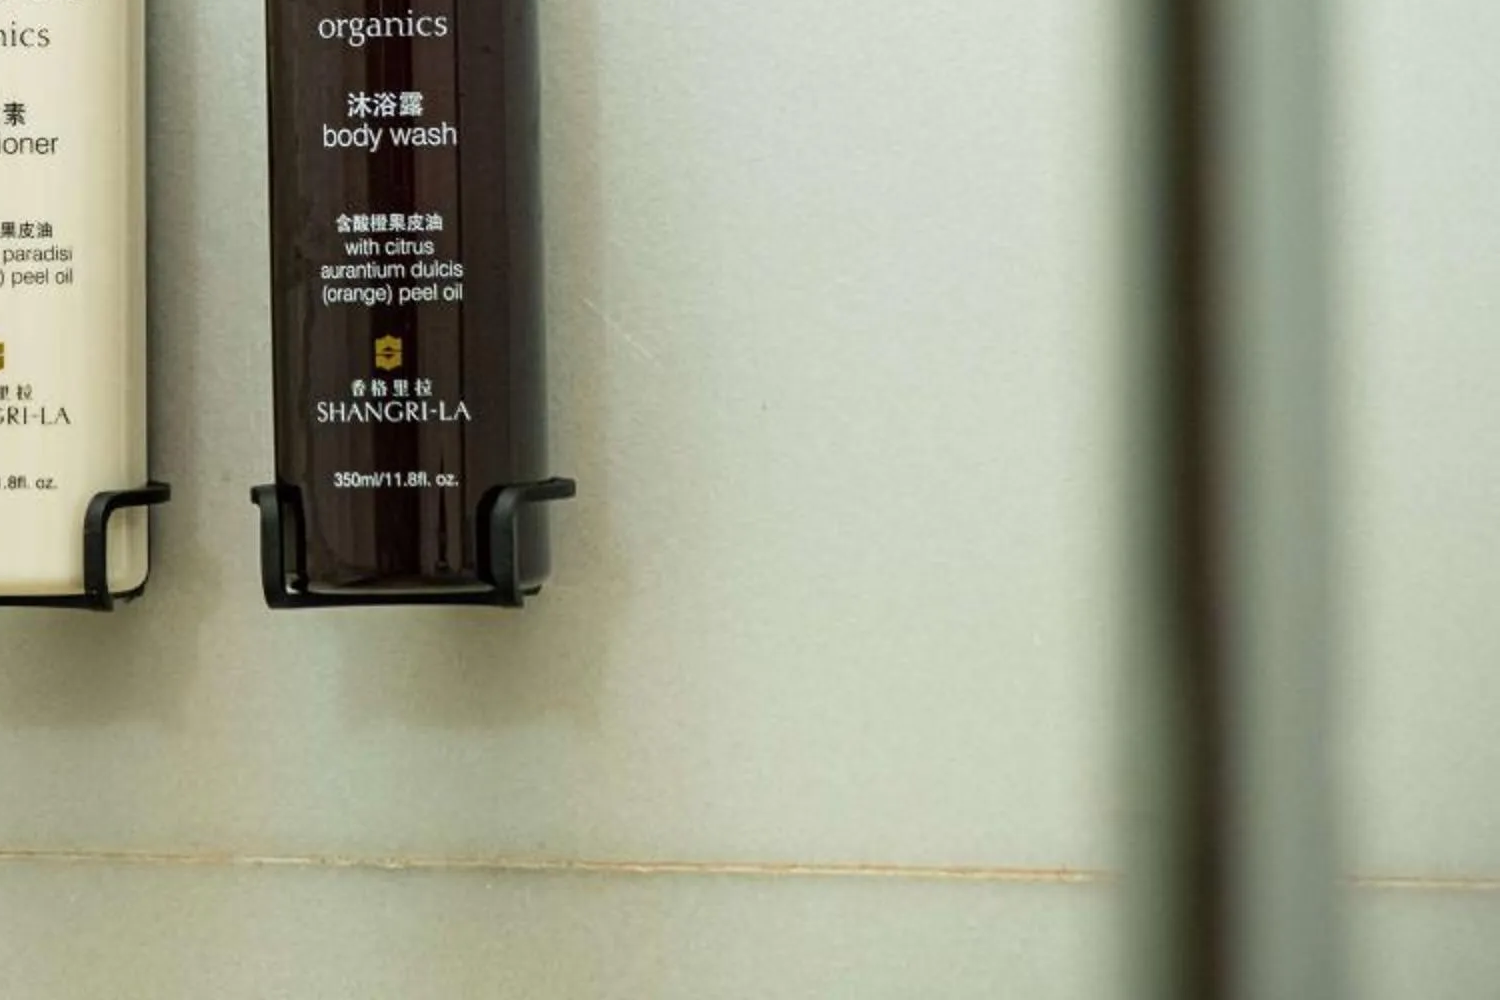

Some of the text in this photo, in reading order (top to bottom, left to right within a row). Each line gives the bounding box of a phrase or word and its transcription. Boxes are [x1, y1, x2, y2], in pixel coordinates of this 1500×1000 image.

[318, 9, 448, 47] organics
[347, 91, 424, 117] 沐浴露
[323, 122, 457, 152] body wash
[336, 213, 443, 233] 含酸橙果皮油
[3, 246, 73, 264] paradisi
[345, 238, 435, 256] with citrus
[12, 268, 49, 288] peel
[55, 268, 73, 284] oil
[321, 261, 464, 279] aurantium dulcis
[323, 283, 463, 306] (orange) peel oil
[352, 379, 432, 397] 香格里拉
[317, 401, 471, 422] SHANGRI-LA
[35, 477, 58, 489] oz.
[334, 472, 459, 488] 350ml/11.8fl. oz.
